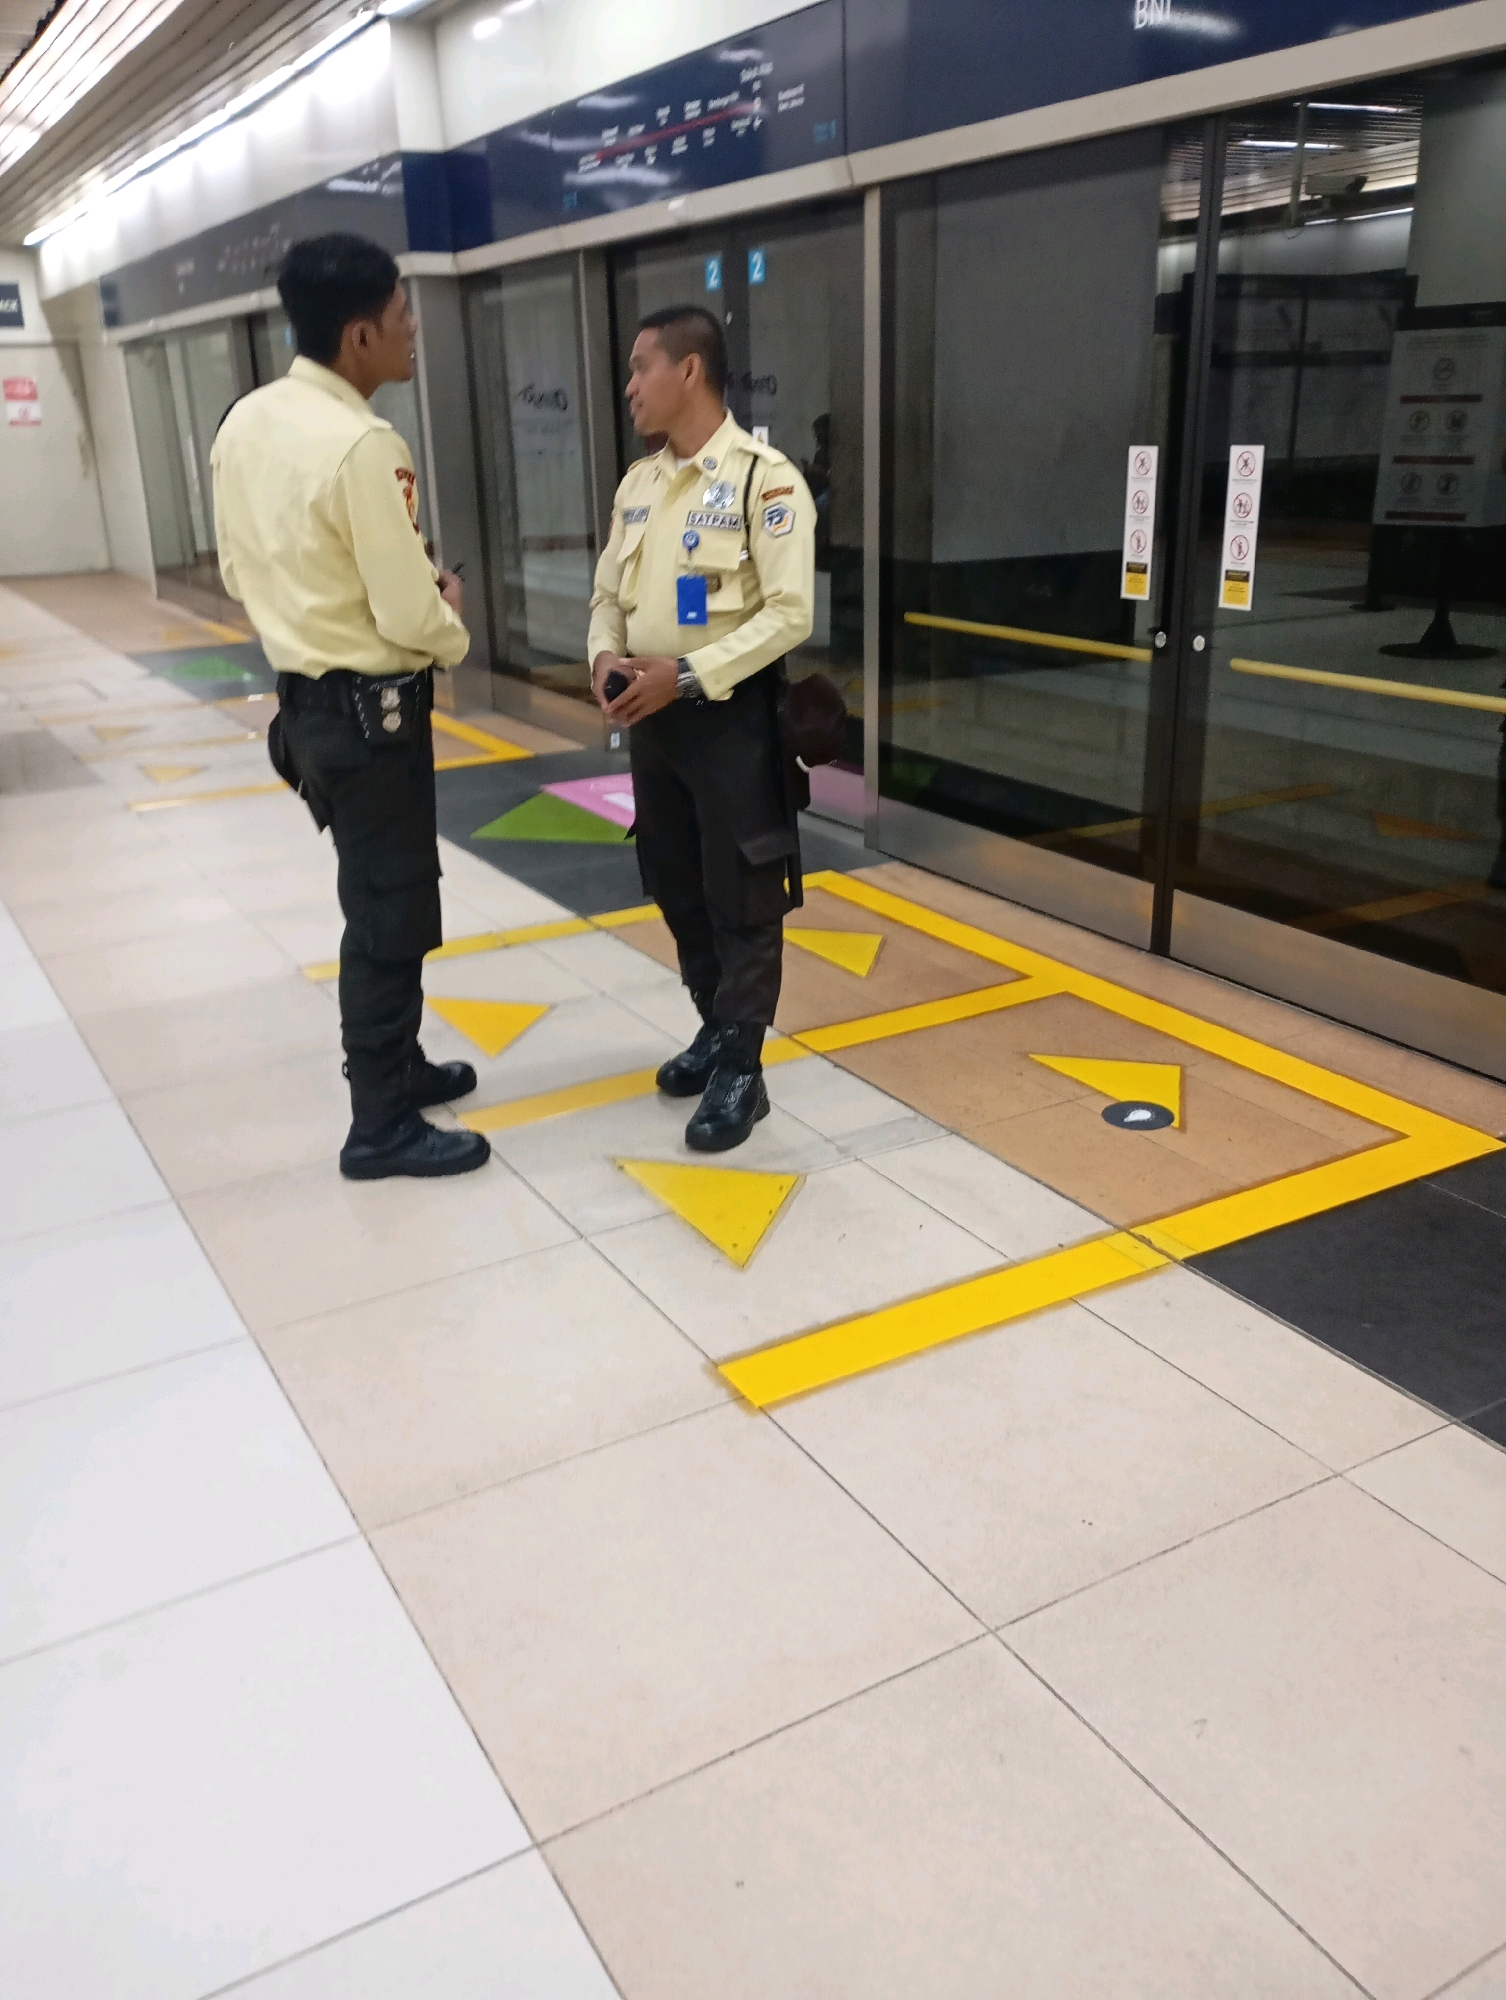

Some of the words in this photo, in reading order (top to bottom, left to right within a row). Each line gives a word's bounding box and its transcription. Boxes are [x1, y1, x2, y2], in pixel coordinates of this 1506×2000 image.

[1134, 0, 1171, 29] BNI
[709, 259, 719, 289] 2
[752, 251, 762, 281] 2
[689, 512, 740, 530] SATPAM
